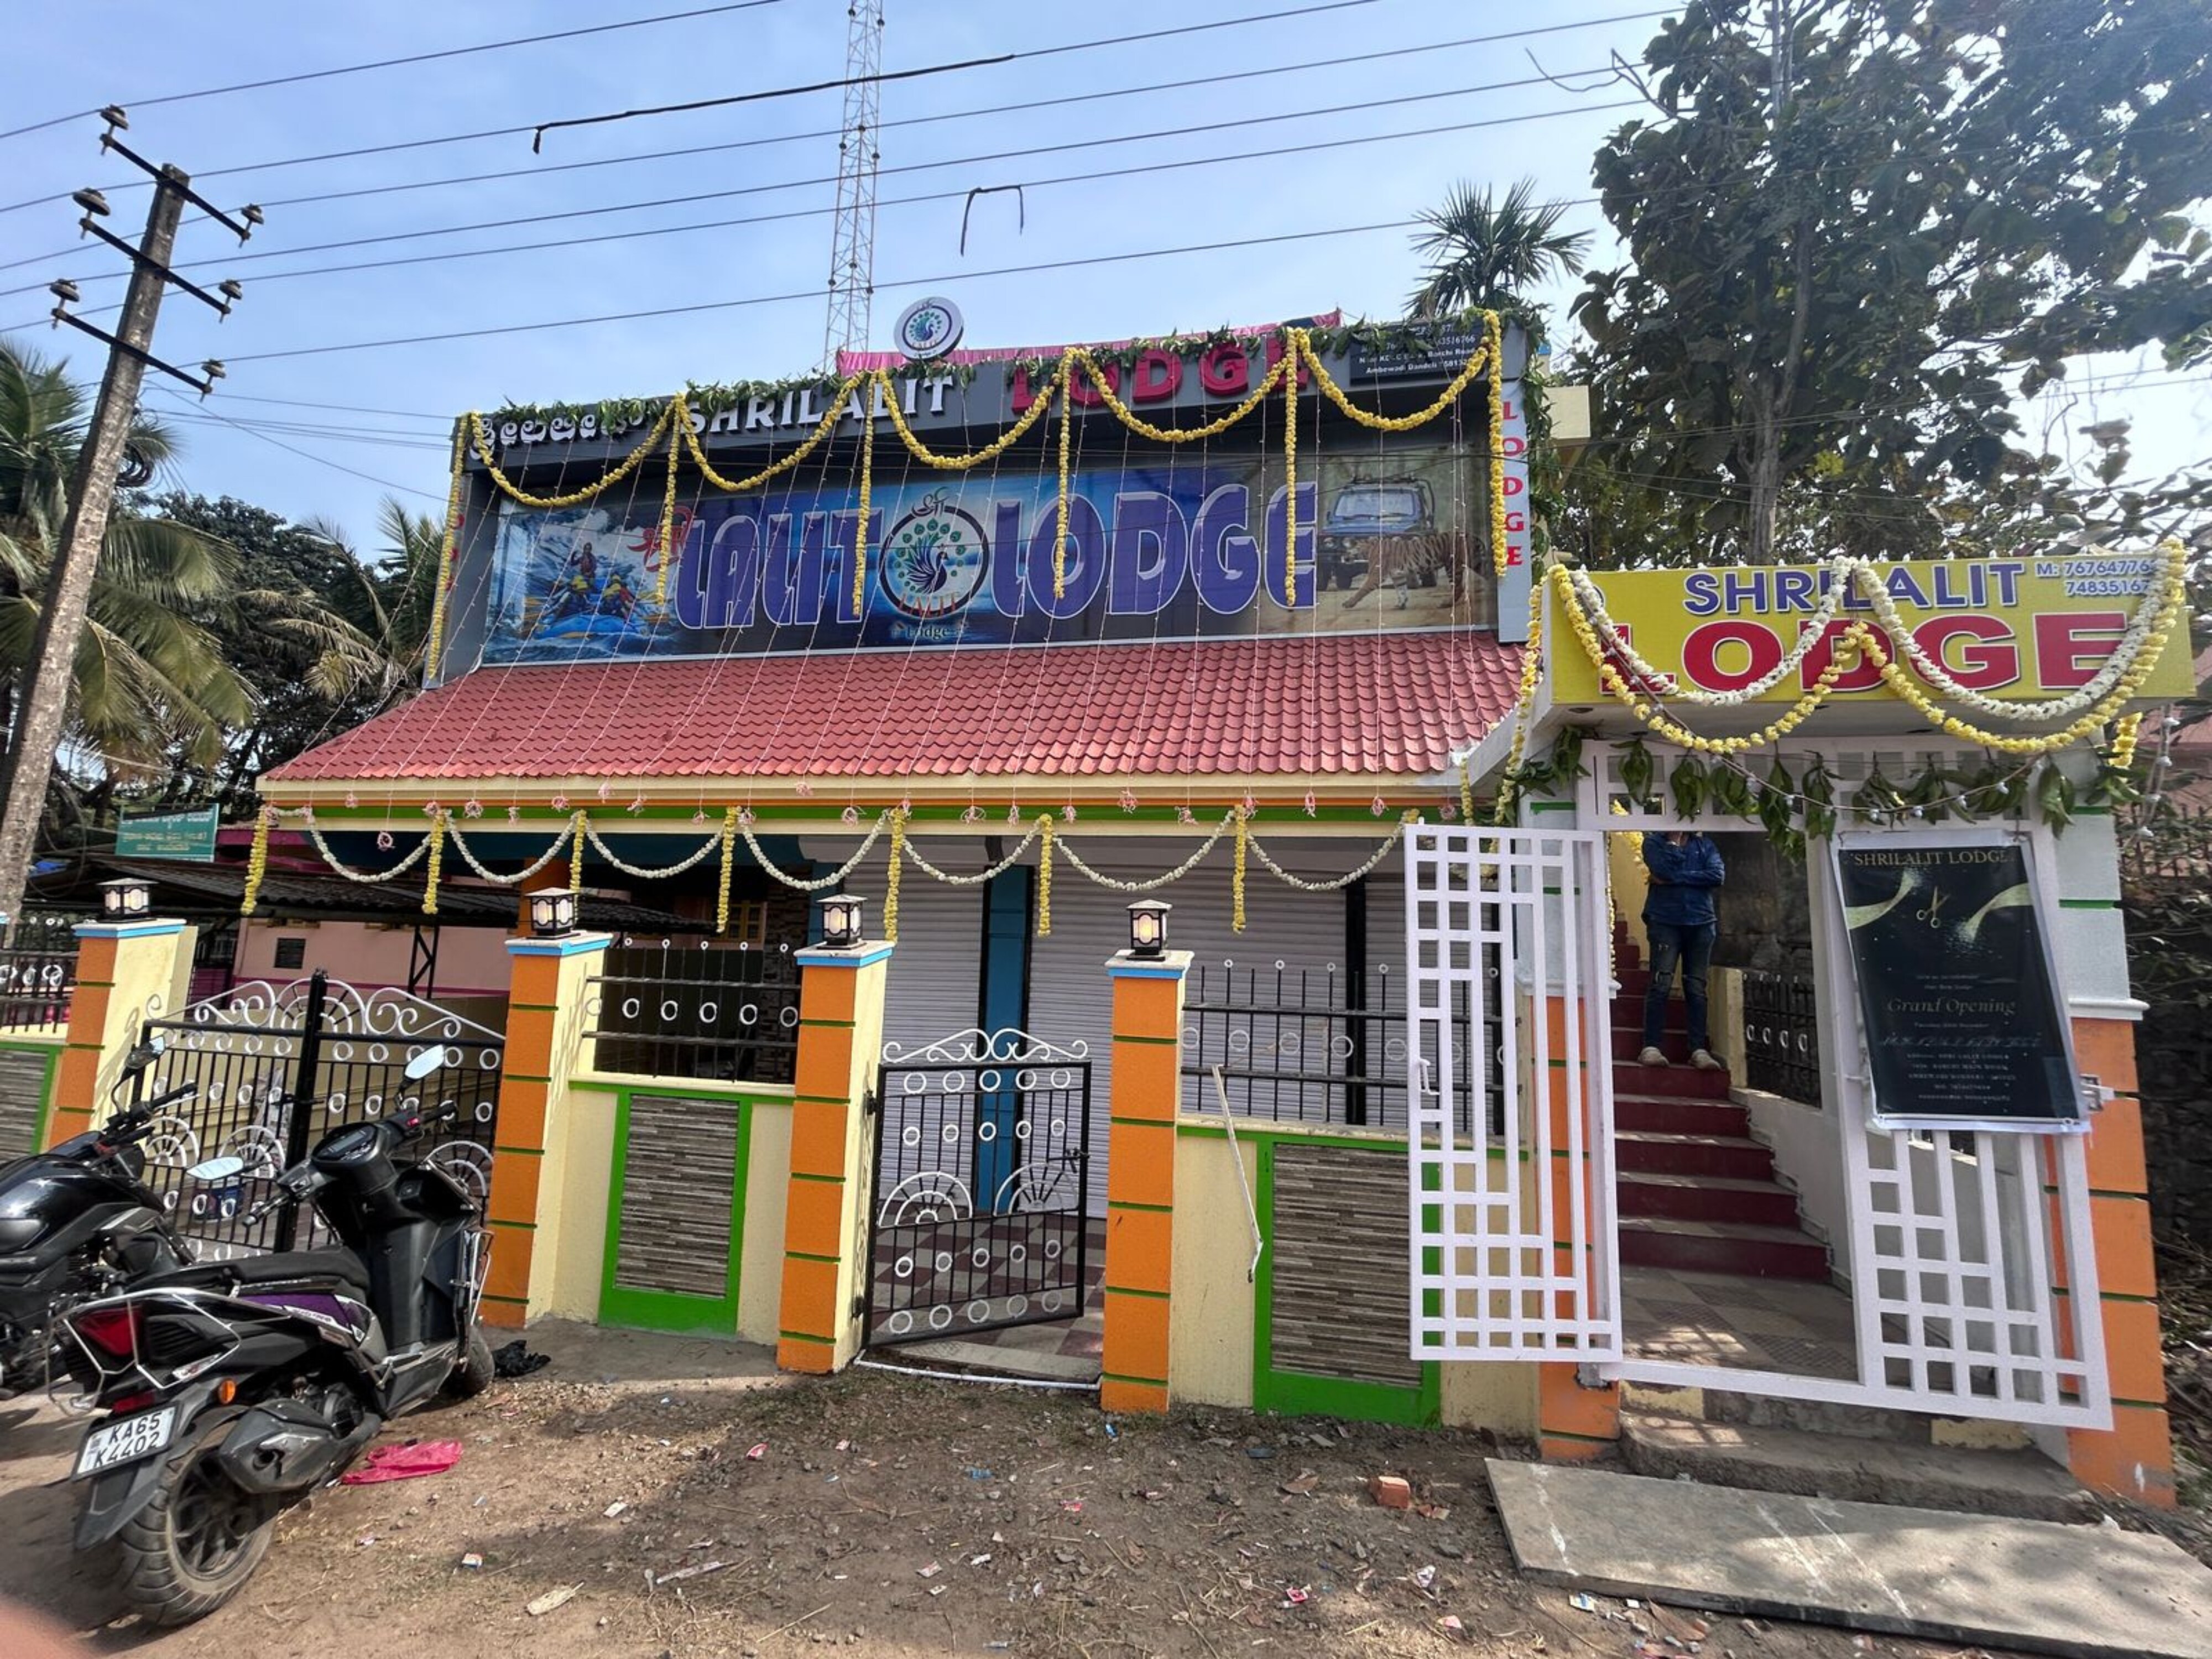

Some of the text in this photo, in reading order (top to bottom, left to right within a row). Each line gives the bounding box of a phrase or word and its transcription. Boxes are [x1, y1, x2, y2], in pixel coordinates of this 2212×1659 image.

[1503, 401, 1527, 566] LODGE
[992, 482, 1317, 619] LODGE
[2036, 559, 2156, 576] M: 76764776
[1684, 562, 2024, 614] SHRILALIT
[1600, 612, 2127, 695] LODGE
[1887, 997, 2016, 1016] Grand Opening
[94, 1432, 159, 1468] K4402
[109, 1412, 162, 1445] KA65
